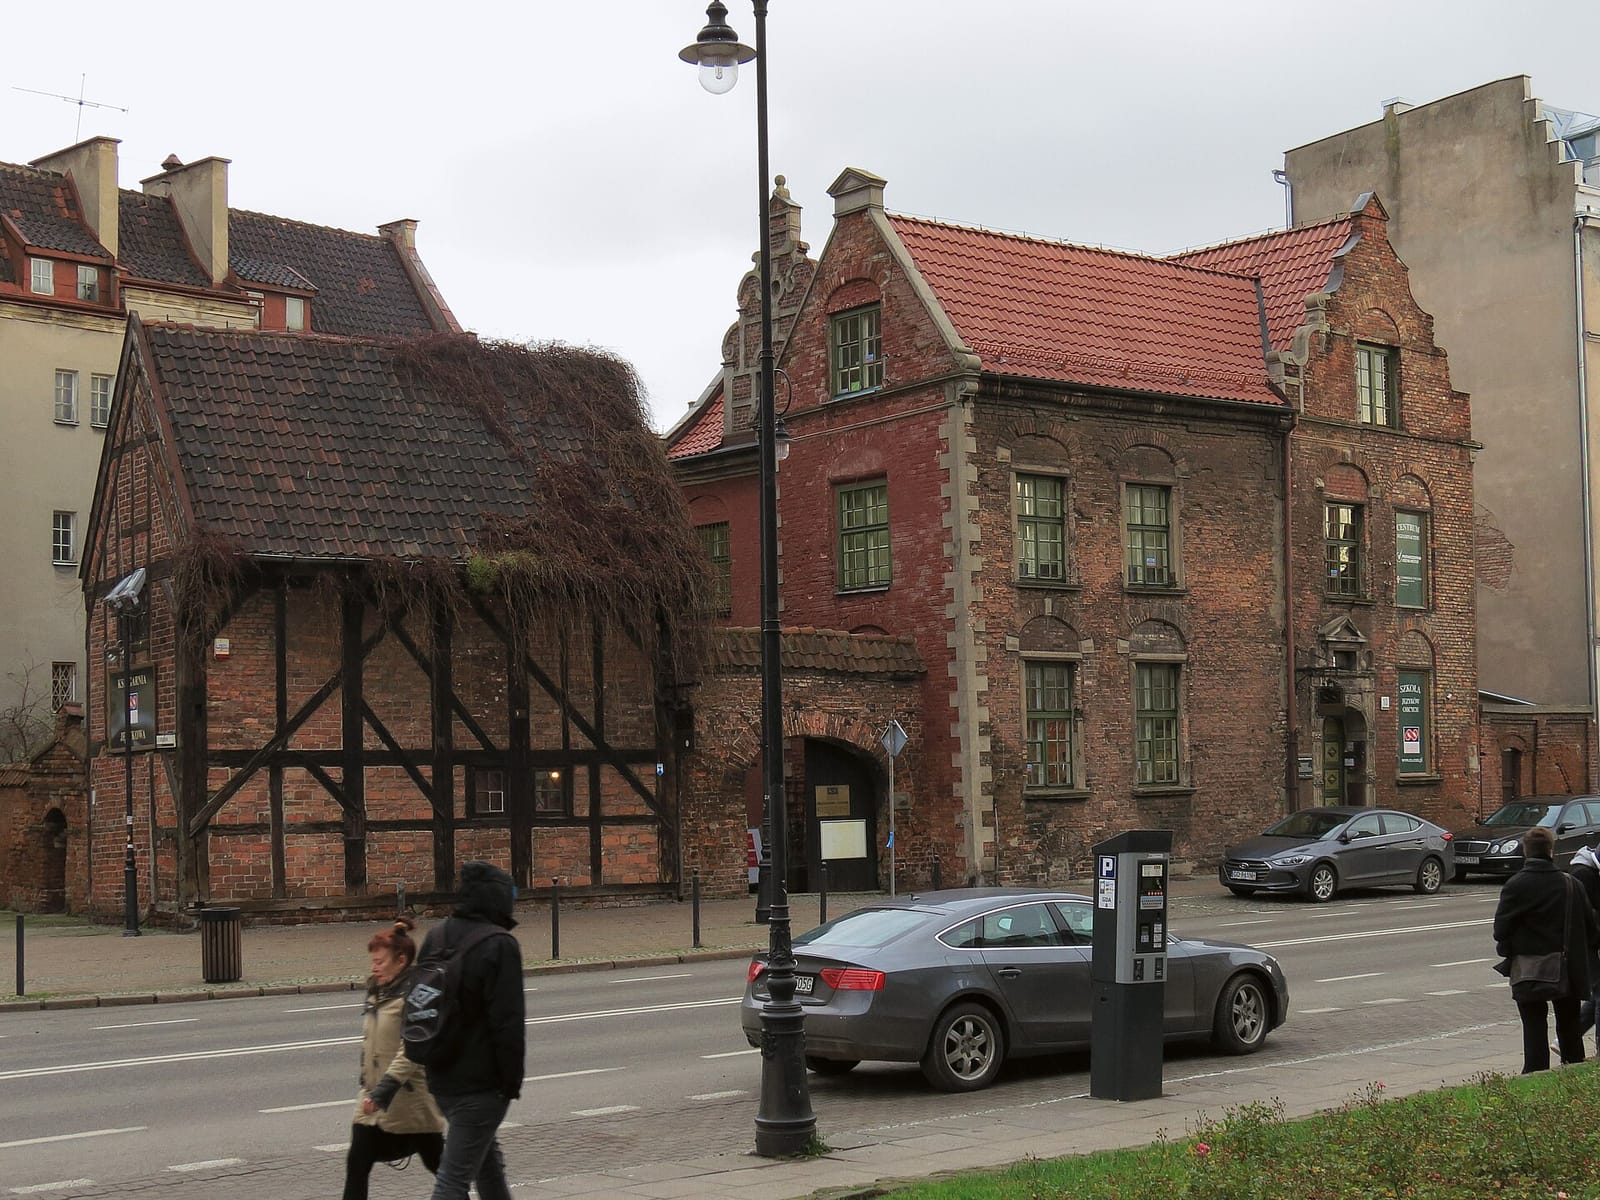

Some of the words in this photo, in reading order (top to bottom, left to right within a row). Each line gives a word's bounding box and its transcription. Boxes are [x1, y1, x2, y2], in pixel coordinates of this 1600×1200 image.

[1396, 523, 1420, 534] CENTRUM
[117, 675, 147, 688] KSGARNIA
[1102, 857, 1113, 876] P
